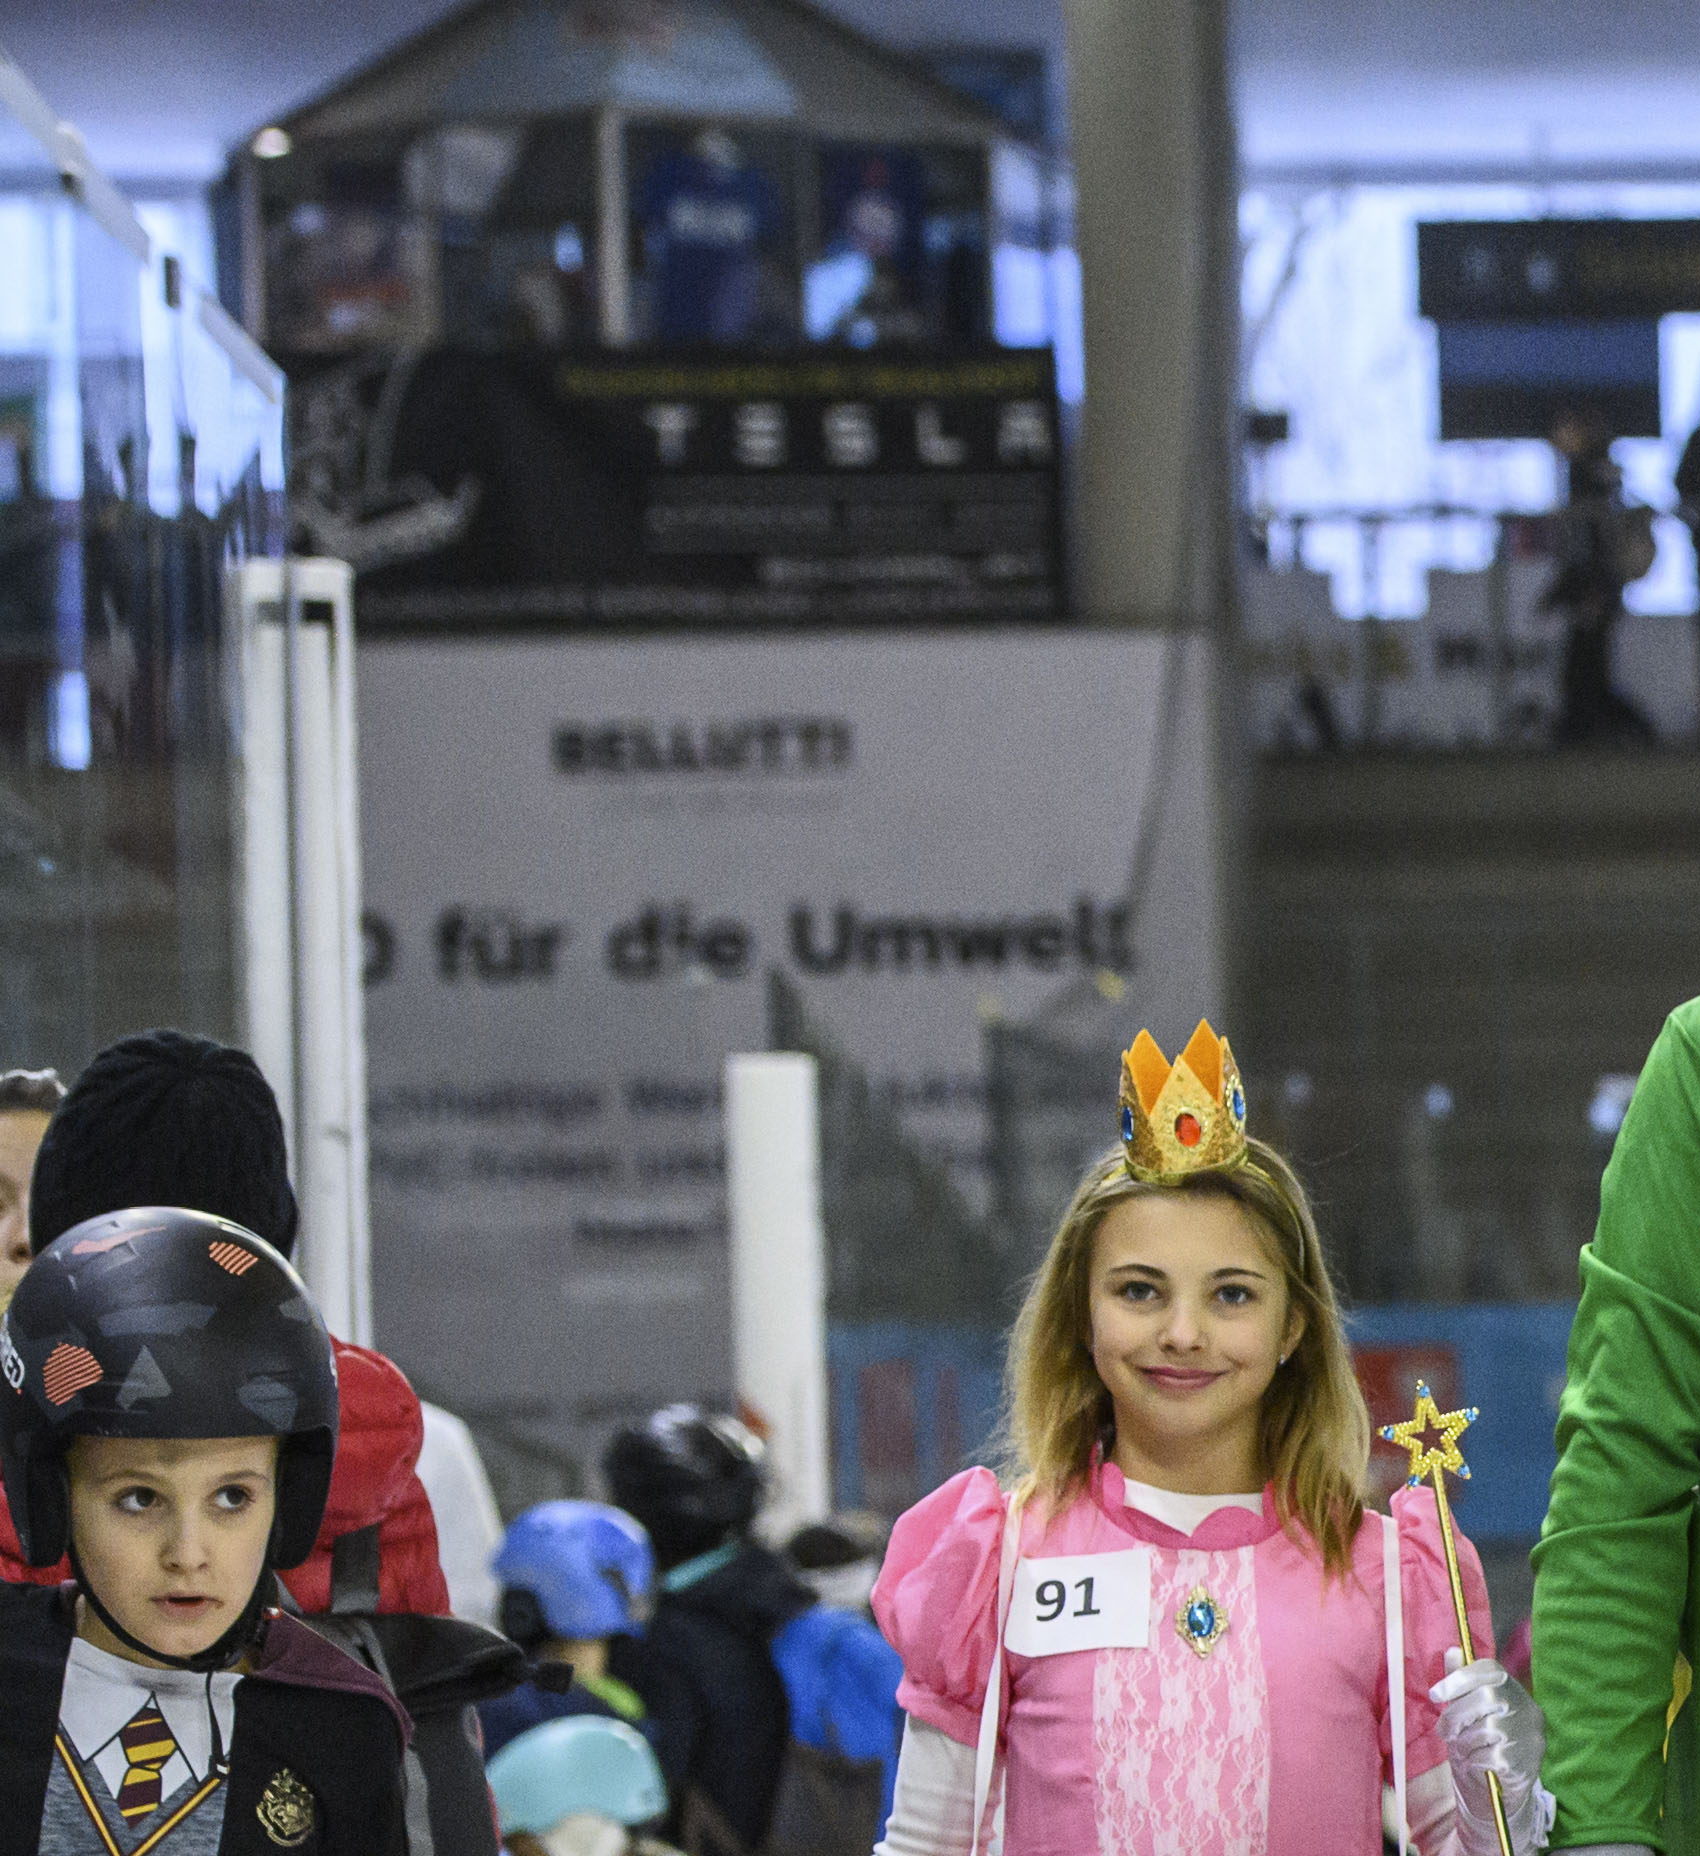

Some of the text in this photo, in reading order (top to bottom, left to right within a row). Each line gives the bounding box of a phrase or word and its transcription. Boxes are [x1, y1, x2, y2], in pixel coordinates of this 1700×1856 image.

[642, 400, 1050, 468] TESLA
[434, 902, 565, 982] für
[1034, 1576, 1101, 1621] 91
